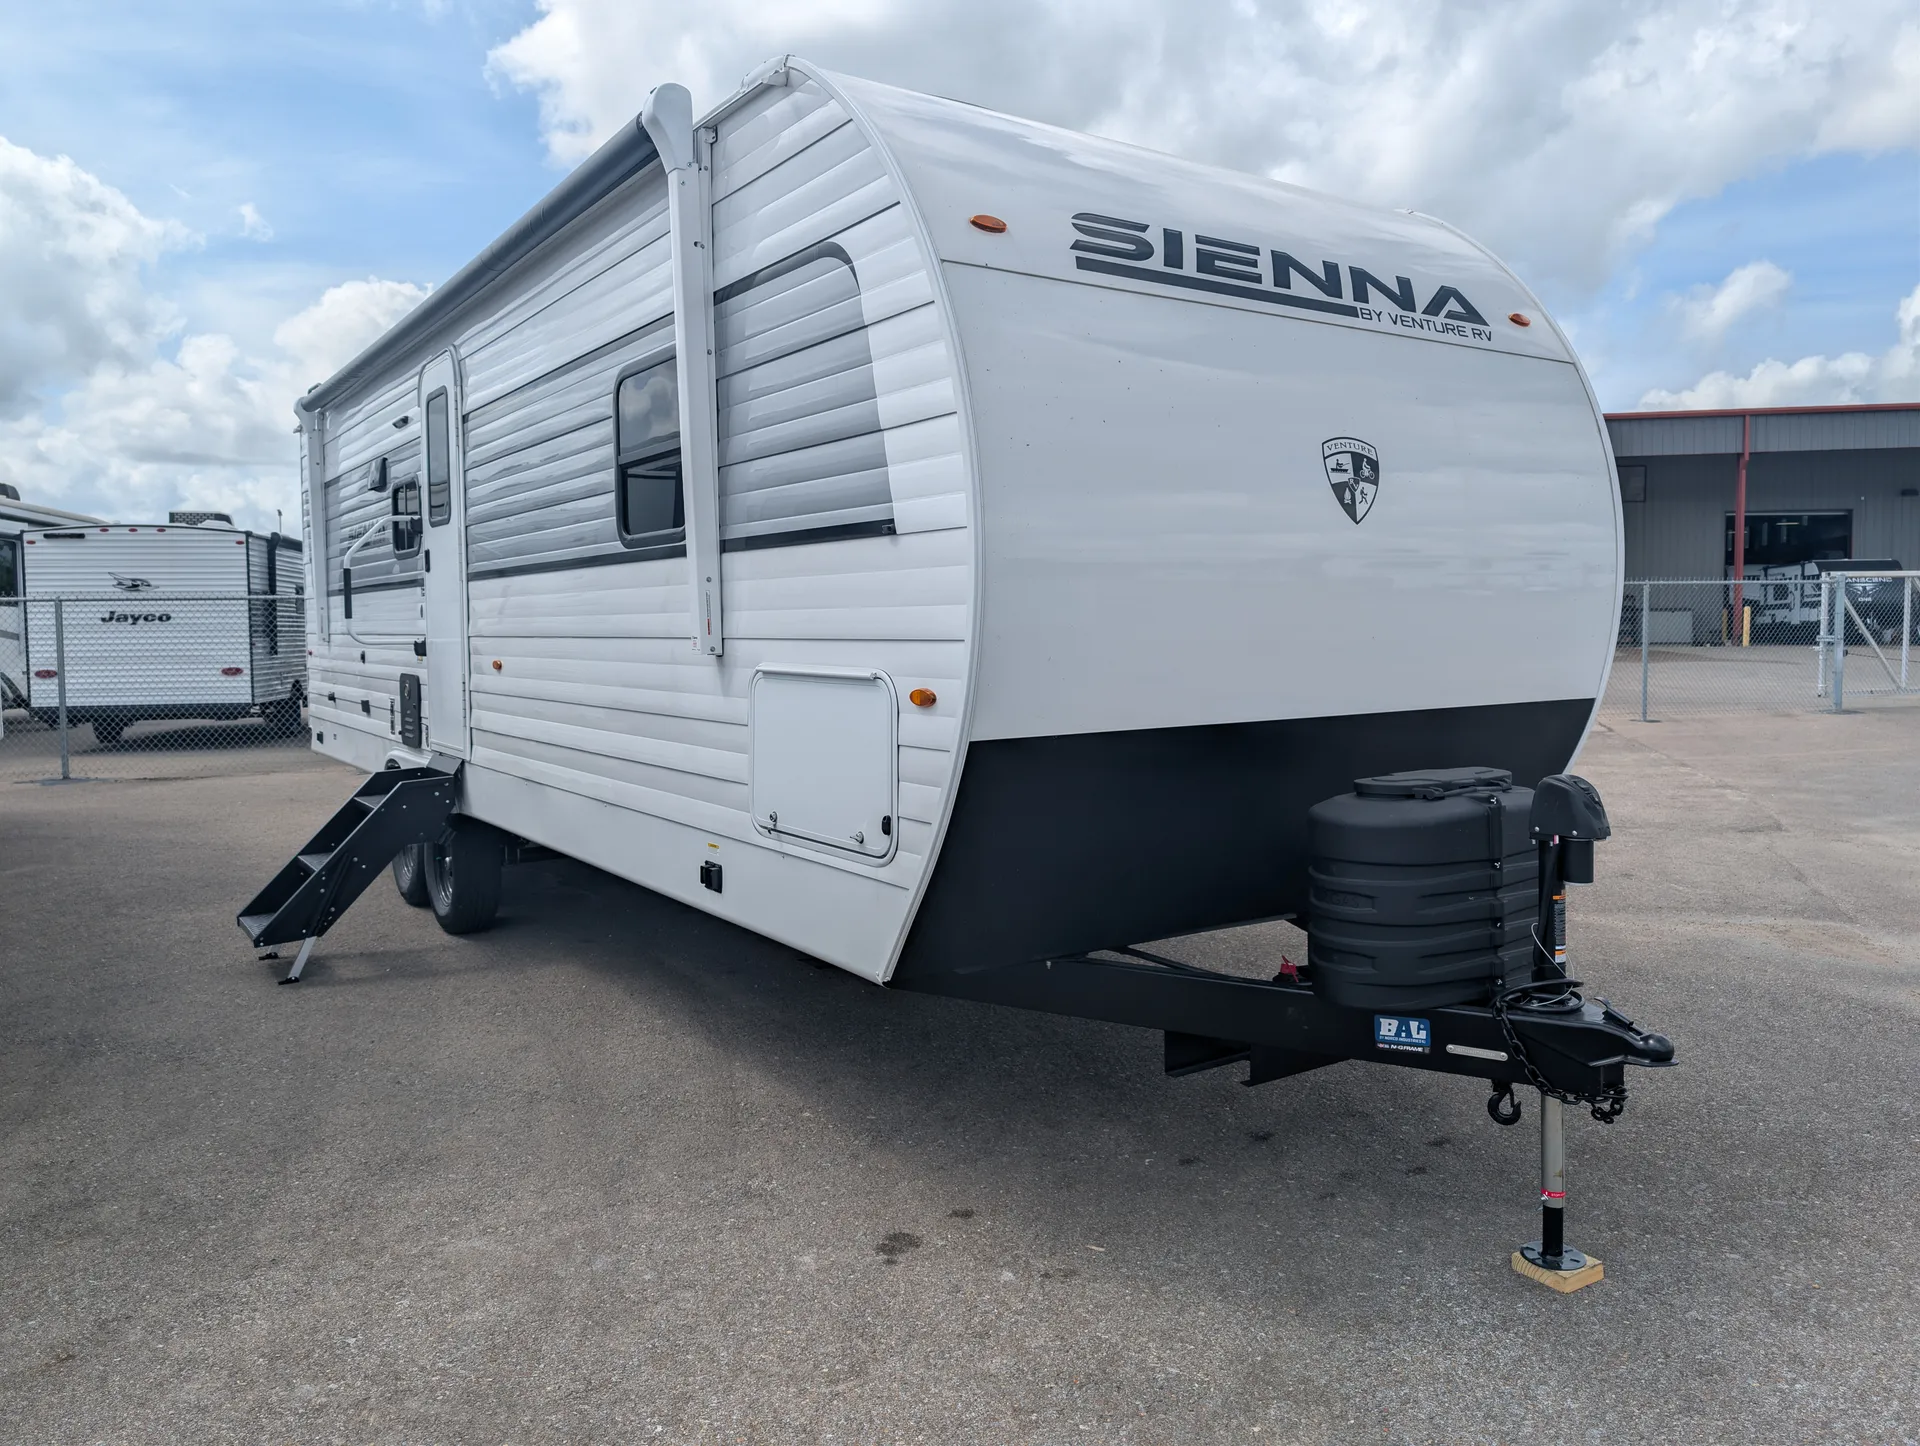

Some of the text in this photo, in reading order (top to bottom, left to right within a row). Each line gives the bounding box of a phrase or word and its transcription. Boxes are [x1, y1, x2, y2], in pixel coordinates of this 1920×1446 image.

[1070, 212, 1490, 326] SIENNA
[1360, 307, 1492, 342] BY VENTURE RV
[1327, 442, 1373, 455] VENTURE
[100, 611, 172, 626] Jayco
